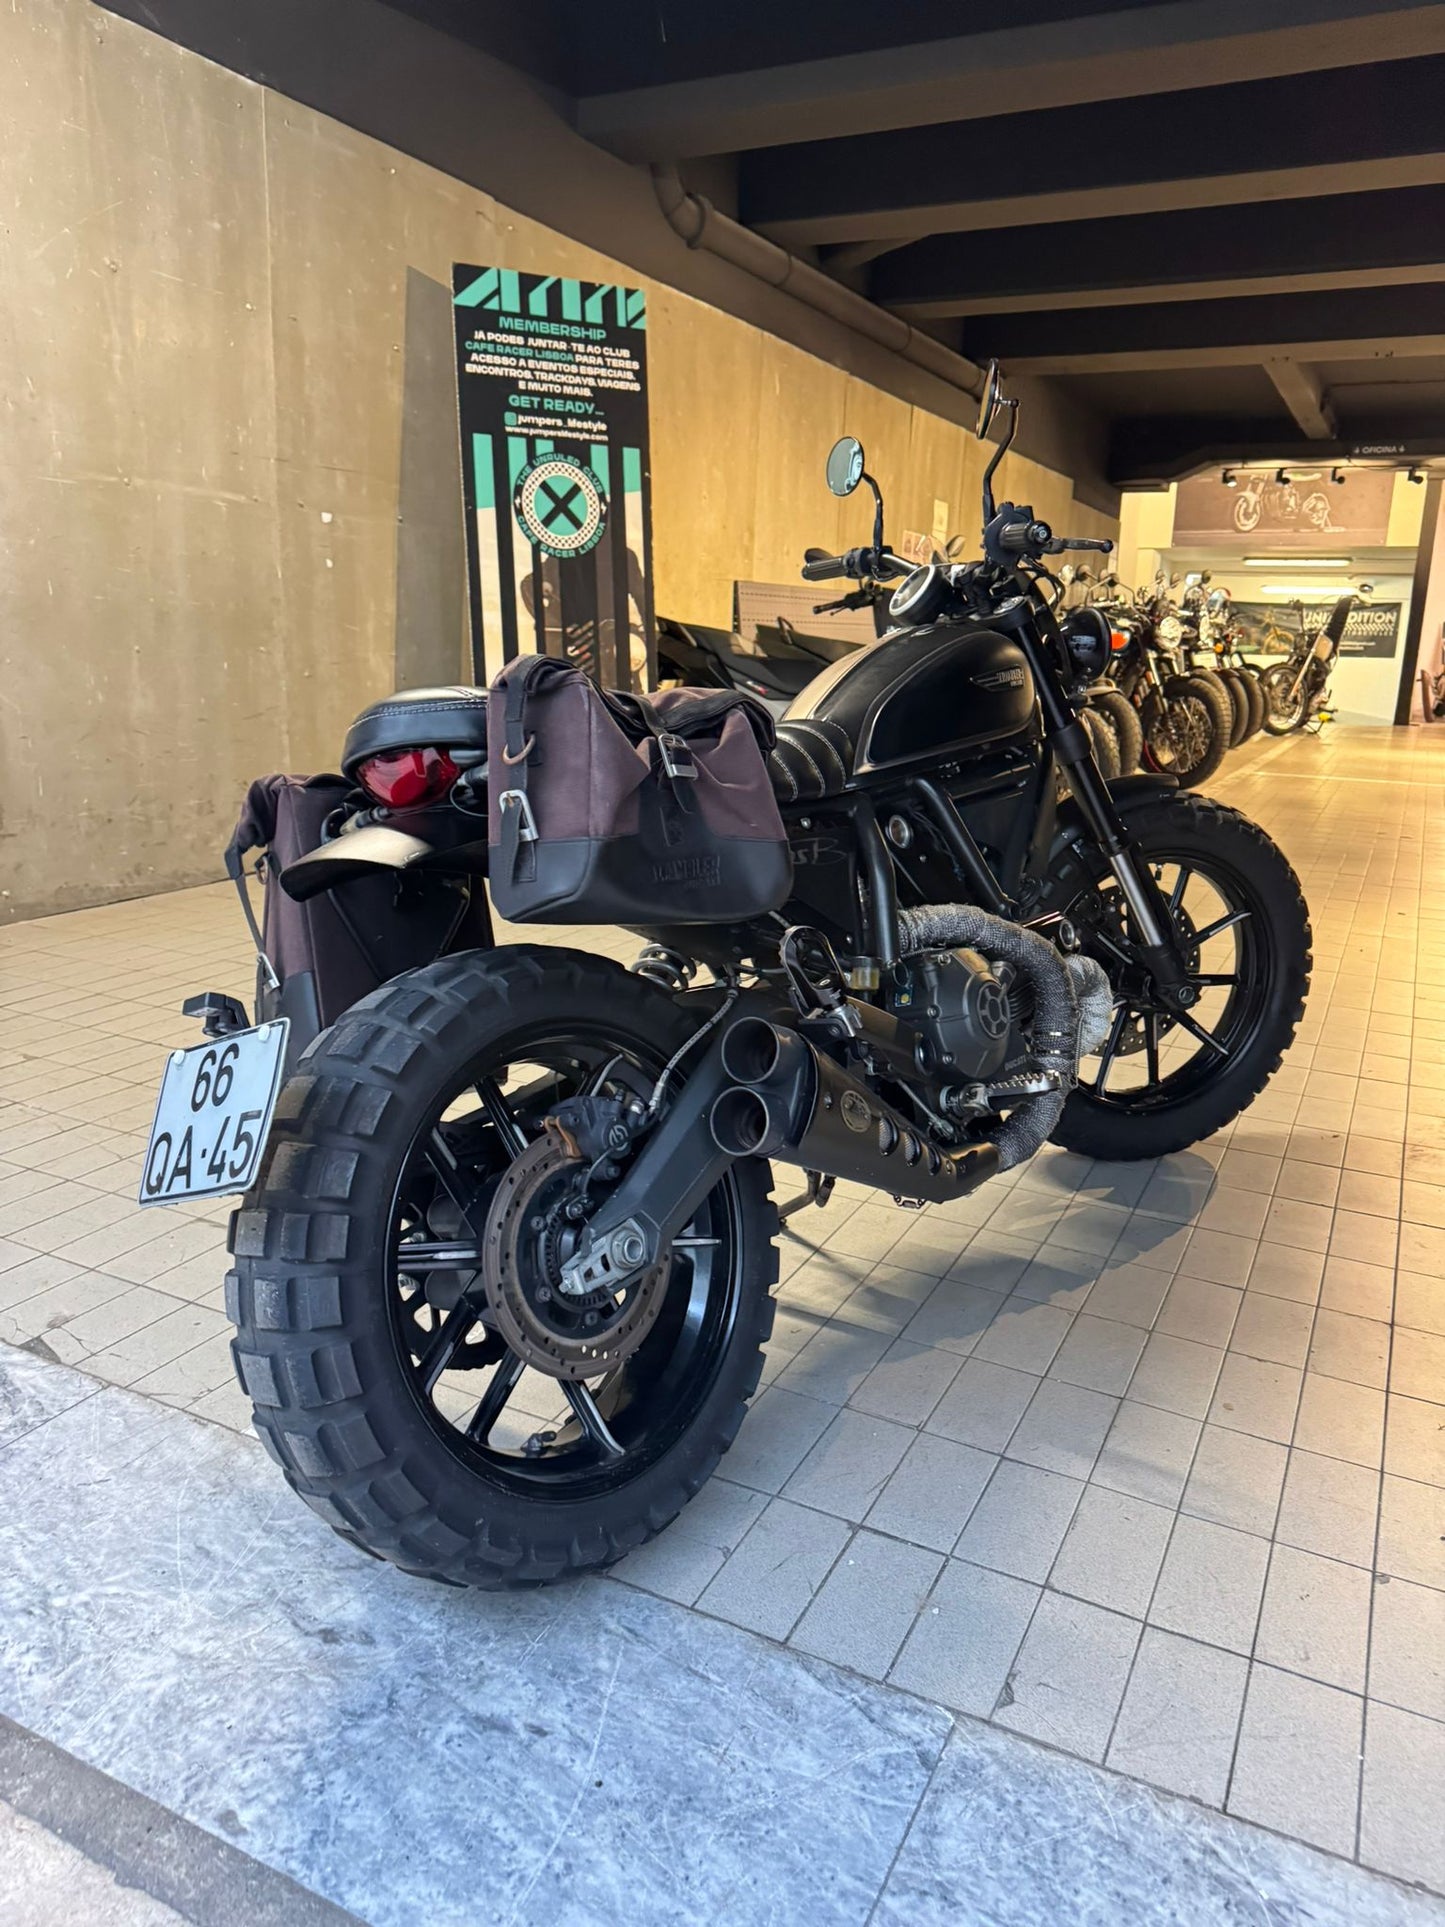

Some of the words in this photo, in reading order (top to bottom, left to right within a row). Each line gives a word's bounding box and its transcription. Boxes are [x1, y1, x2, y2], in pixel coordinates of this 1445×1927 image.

[499, 316, 606, 340] MEMBERSHIP
[465, 341, 495, 353] CAFE
[496, 344, 533, 357] RACER
[535, 349, 574, 362] LISBOA
[575, 354, 604, 366] PARA
[605, 358, 640, 370] TERES
[487, 332, 525, 345] PODES
[587, 344, 601, 354] AO
[603, 346, 631, 358] CLUB
[470, 352, 517, 366] ACESSO
[518, 358, 527, 368] A
[528, 359, 578, 373] EVENTOS
[518, 380, 526, 390] E
[528, 381, 562, 394] MUITO
[597, 378, 641, 392] VIAGENS
[508, 394, 541, 409] GET
[517, 465, 533, 486] THE
[532, 453, 581, 467] UNRULED
[540, 543, 576, 558] RACER
[578, 522, 606, 555] LISBOA
[1303, 609, 1332, 623] UNI
[1347, 611, 1397, 624] DITION
[190, 1042, 240, 1113] 66
